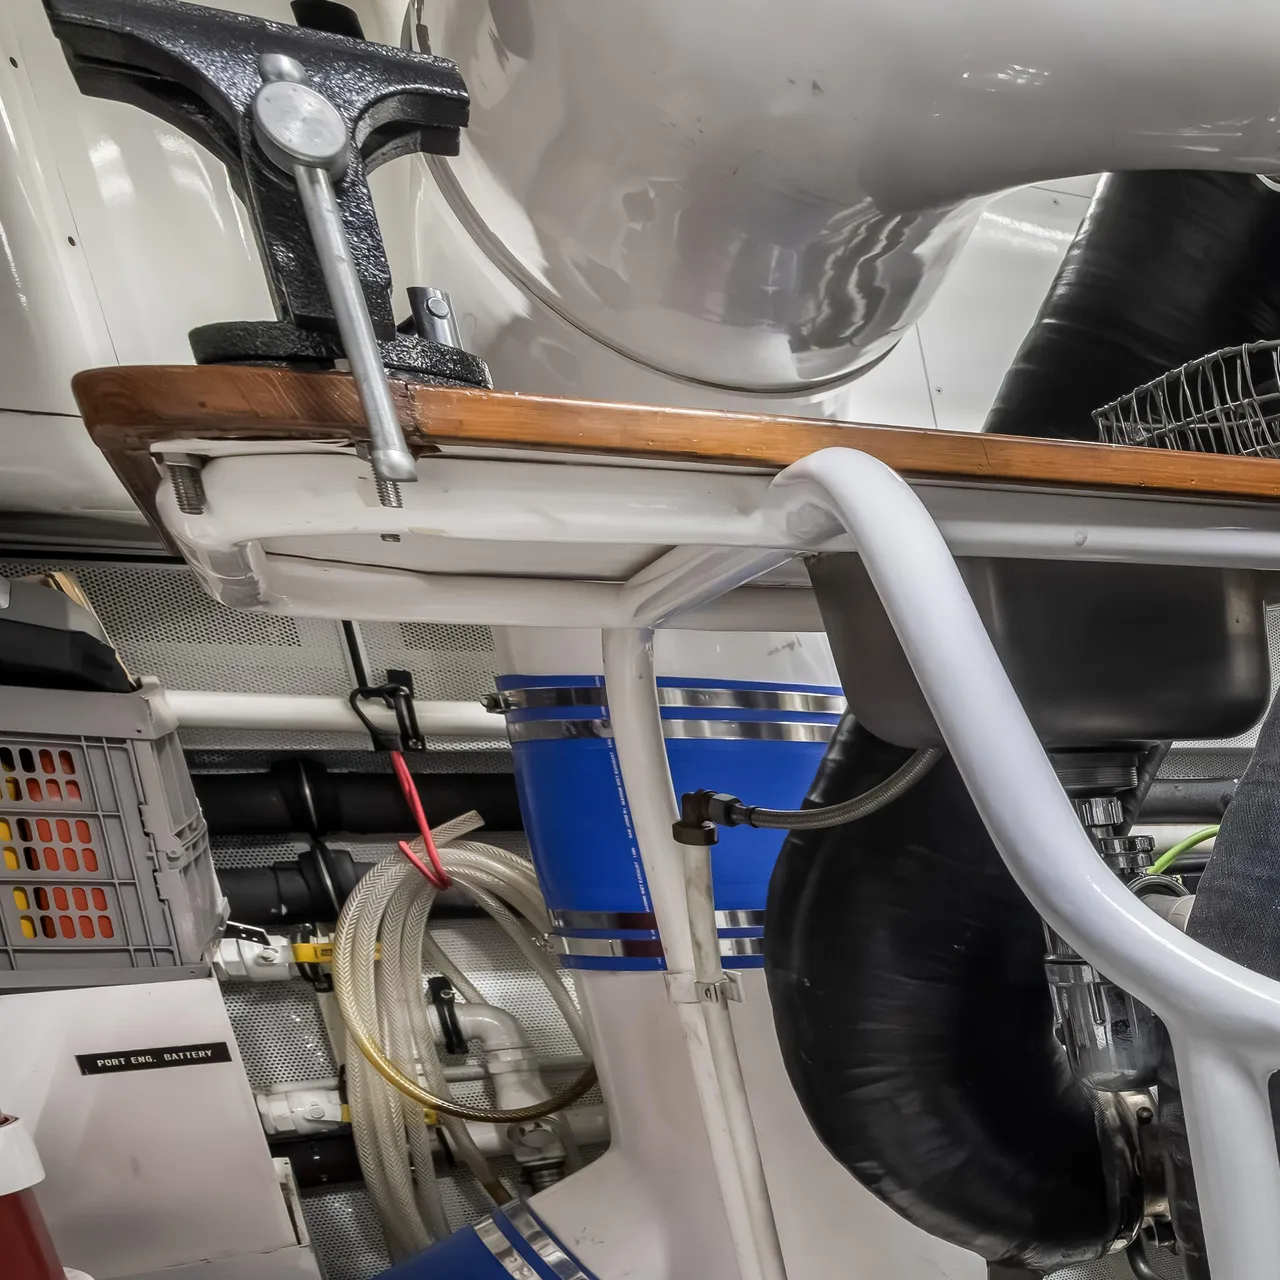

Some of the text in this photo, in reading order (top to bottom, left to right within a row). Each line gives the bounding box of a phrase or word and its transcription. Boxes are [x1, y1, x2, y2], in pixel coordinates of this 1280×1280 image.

[96, 1049, 213, 1068] PORT ENG. BATTERY
